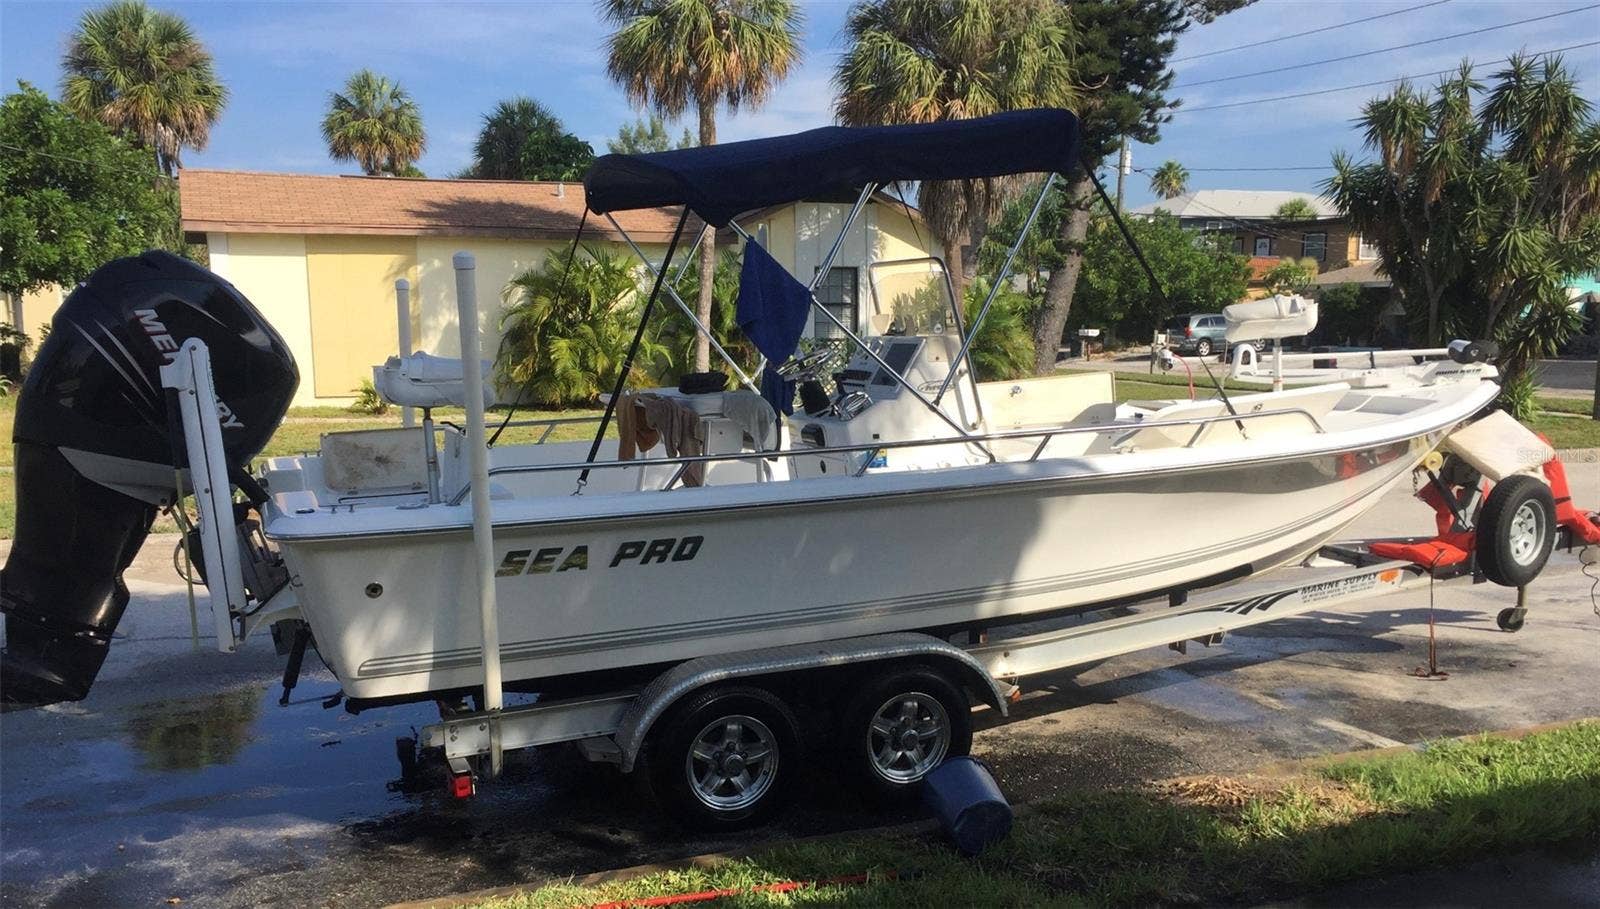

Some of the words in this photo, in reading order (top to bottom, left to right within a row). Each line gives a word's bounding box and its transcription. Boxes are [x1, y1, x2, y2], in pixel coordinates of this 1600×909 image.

[134, 309, 245, 427] MERY
[494, 545, 588, 577] SEA
[609, 535, 704, 568] PRO
[1301, 579, 1341, 594] MARINE
[1343, 572, 1378, 586] SUPPLY
